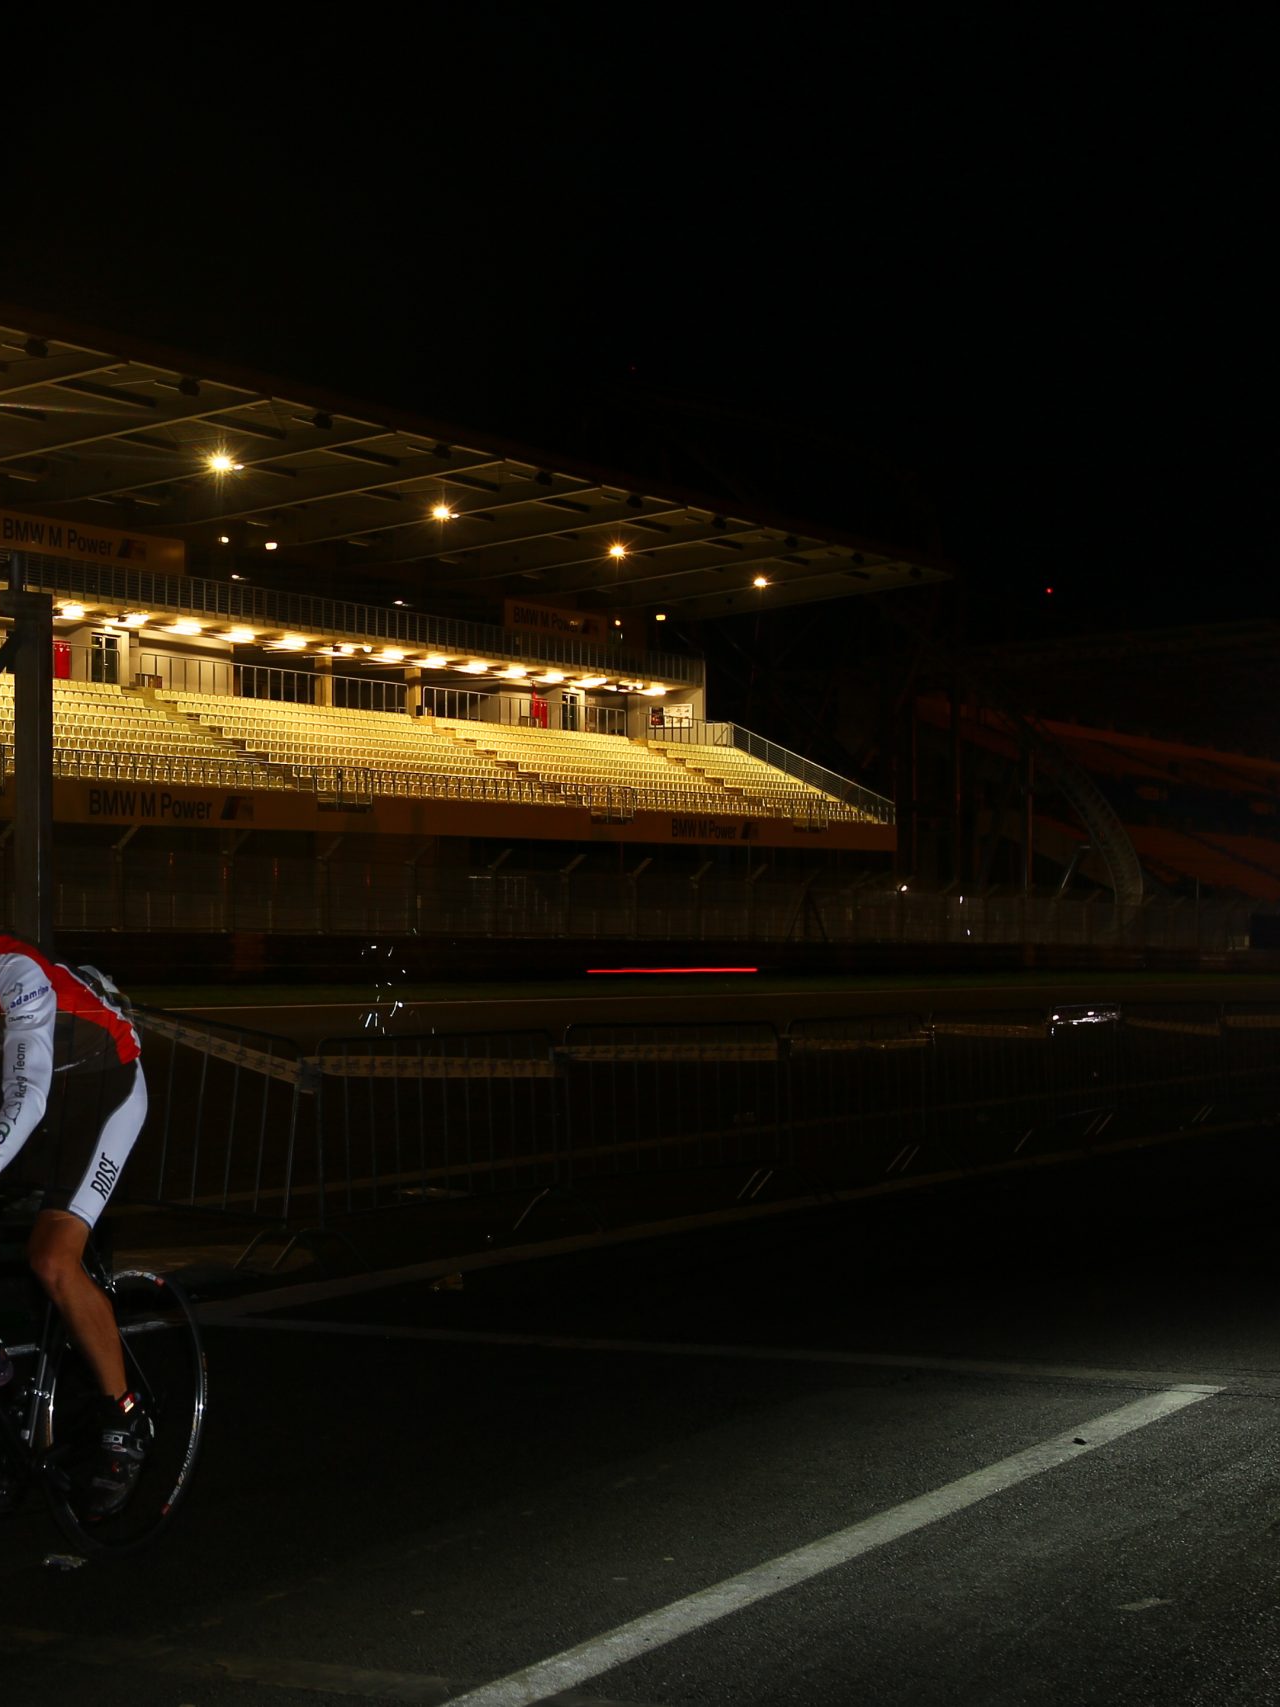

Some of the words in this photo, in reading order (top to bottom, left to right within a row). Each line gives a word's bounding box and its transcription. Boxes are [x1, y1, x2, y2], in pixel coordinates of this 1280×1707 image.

[2, 518, 45, 545] BMW
[48, 525, 63, 549] M
[67, 529, 113, 557] Power
[88, 788, 137, 817] BMW
[140, 791, 156, 818] M
[160, 793, 213, 821] Power
[13, 1043, 26, 1073] Team
[90, 1152, 119, 1201] ROSE
